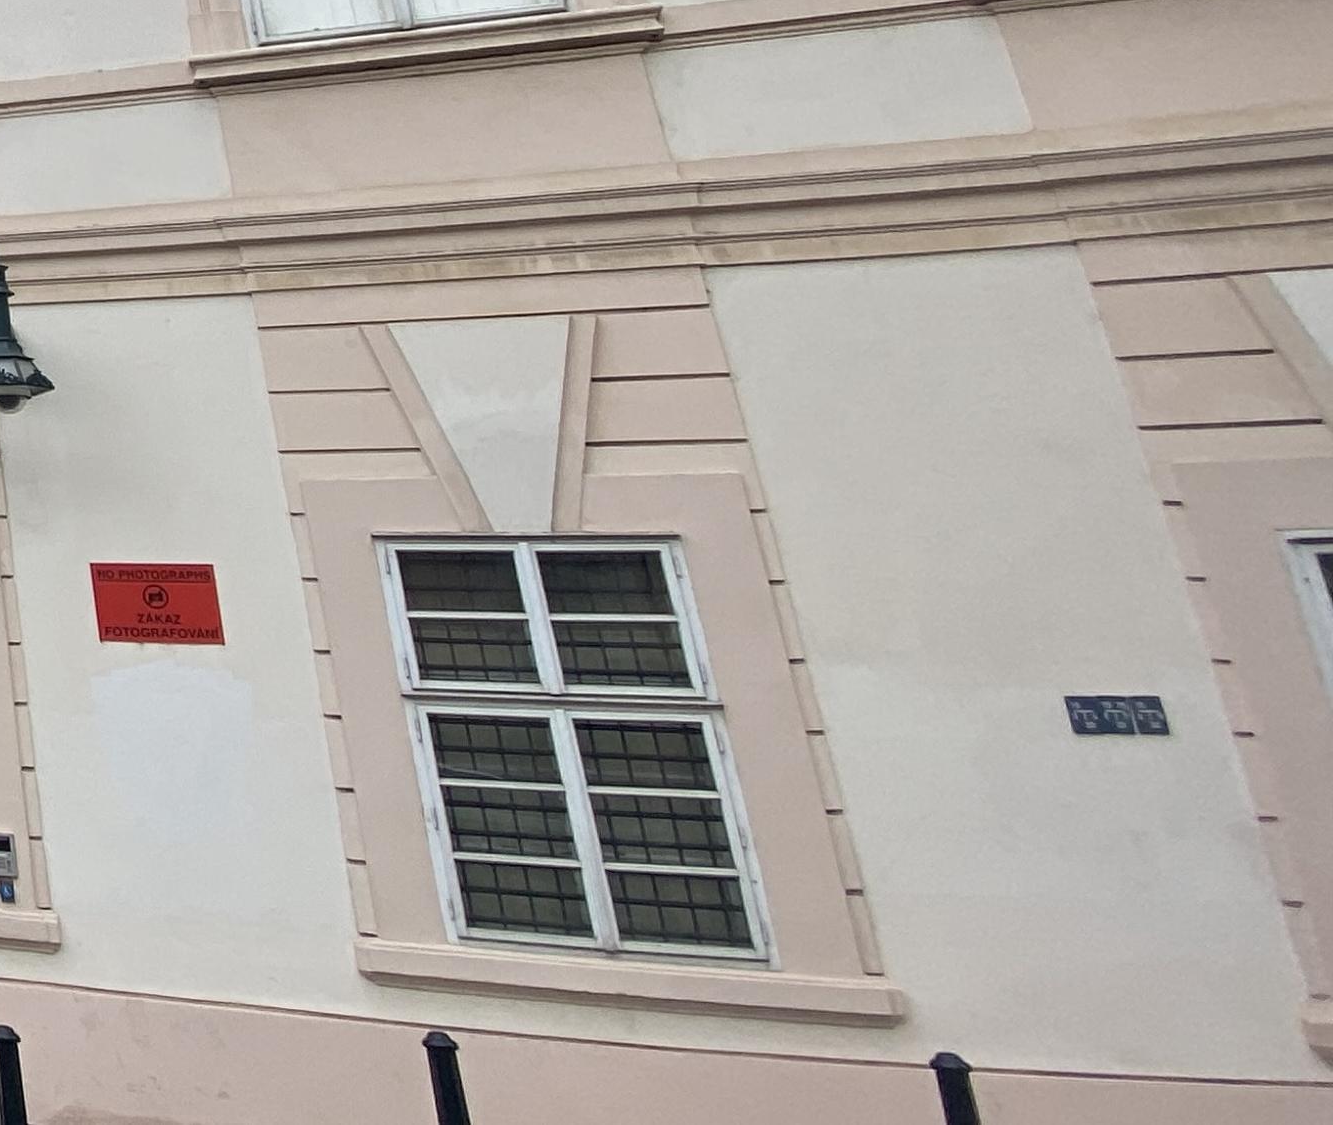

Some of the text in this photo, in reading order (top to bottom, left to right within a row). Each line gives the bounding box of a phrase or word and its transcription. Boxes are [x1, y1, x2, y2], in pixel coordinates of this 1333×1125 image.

[97, 569, 211, 581] NO PHOTOGRAPHS
[137, 612, 181, 625] ZÁKAZ
[104, 626, 220, 640] FOTOGRAFOVÁNÍ
